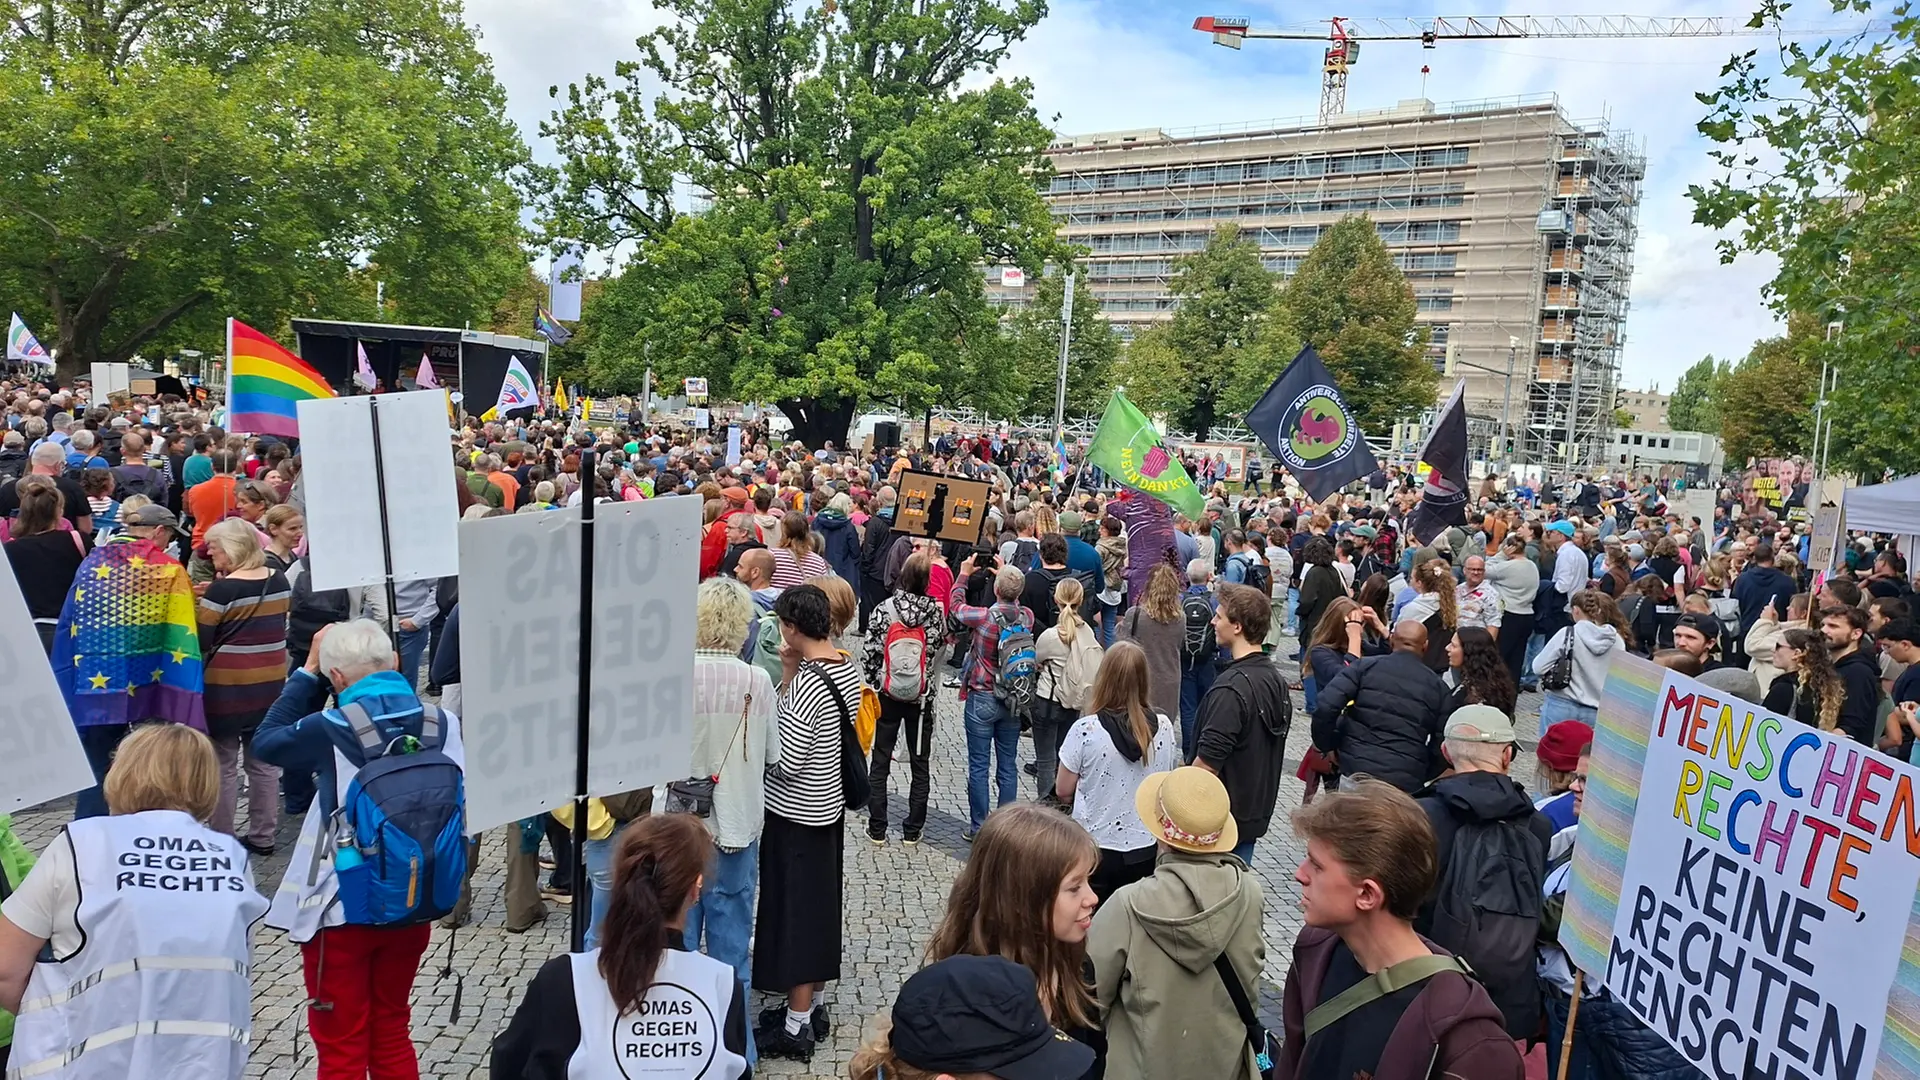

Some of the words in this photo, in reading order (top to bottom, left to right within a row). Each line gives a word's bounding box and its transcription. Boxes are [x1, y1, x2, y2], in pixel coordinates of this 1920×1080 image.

[1294, 387, 1356, 458] ANTIVERSCURBELTE
[1280, 437, 1306, 467] AKTION
[1121, 447, 1141, 484] NEIN
[1138, 475, 1189, 492] DANKE
[133, 836, 225, 853] OMAS
[1673, 760, 1872, 923] RECHTE,
[118, 852, 231, 871] GEGEN
[116, 871, 244, 892] RECHTS
[1674, 838, 1826, 977] KEINE
[1629, 885, 1867, 1080] RECHTEN
[640, 1001, 692, 1015] OMAS
[1606, 935, 1811, 1080] MENSCH
[631, 1021, 697, 1036] GEGEN
[626, 1042, 702, 1058] RECHTS
